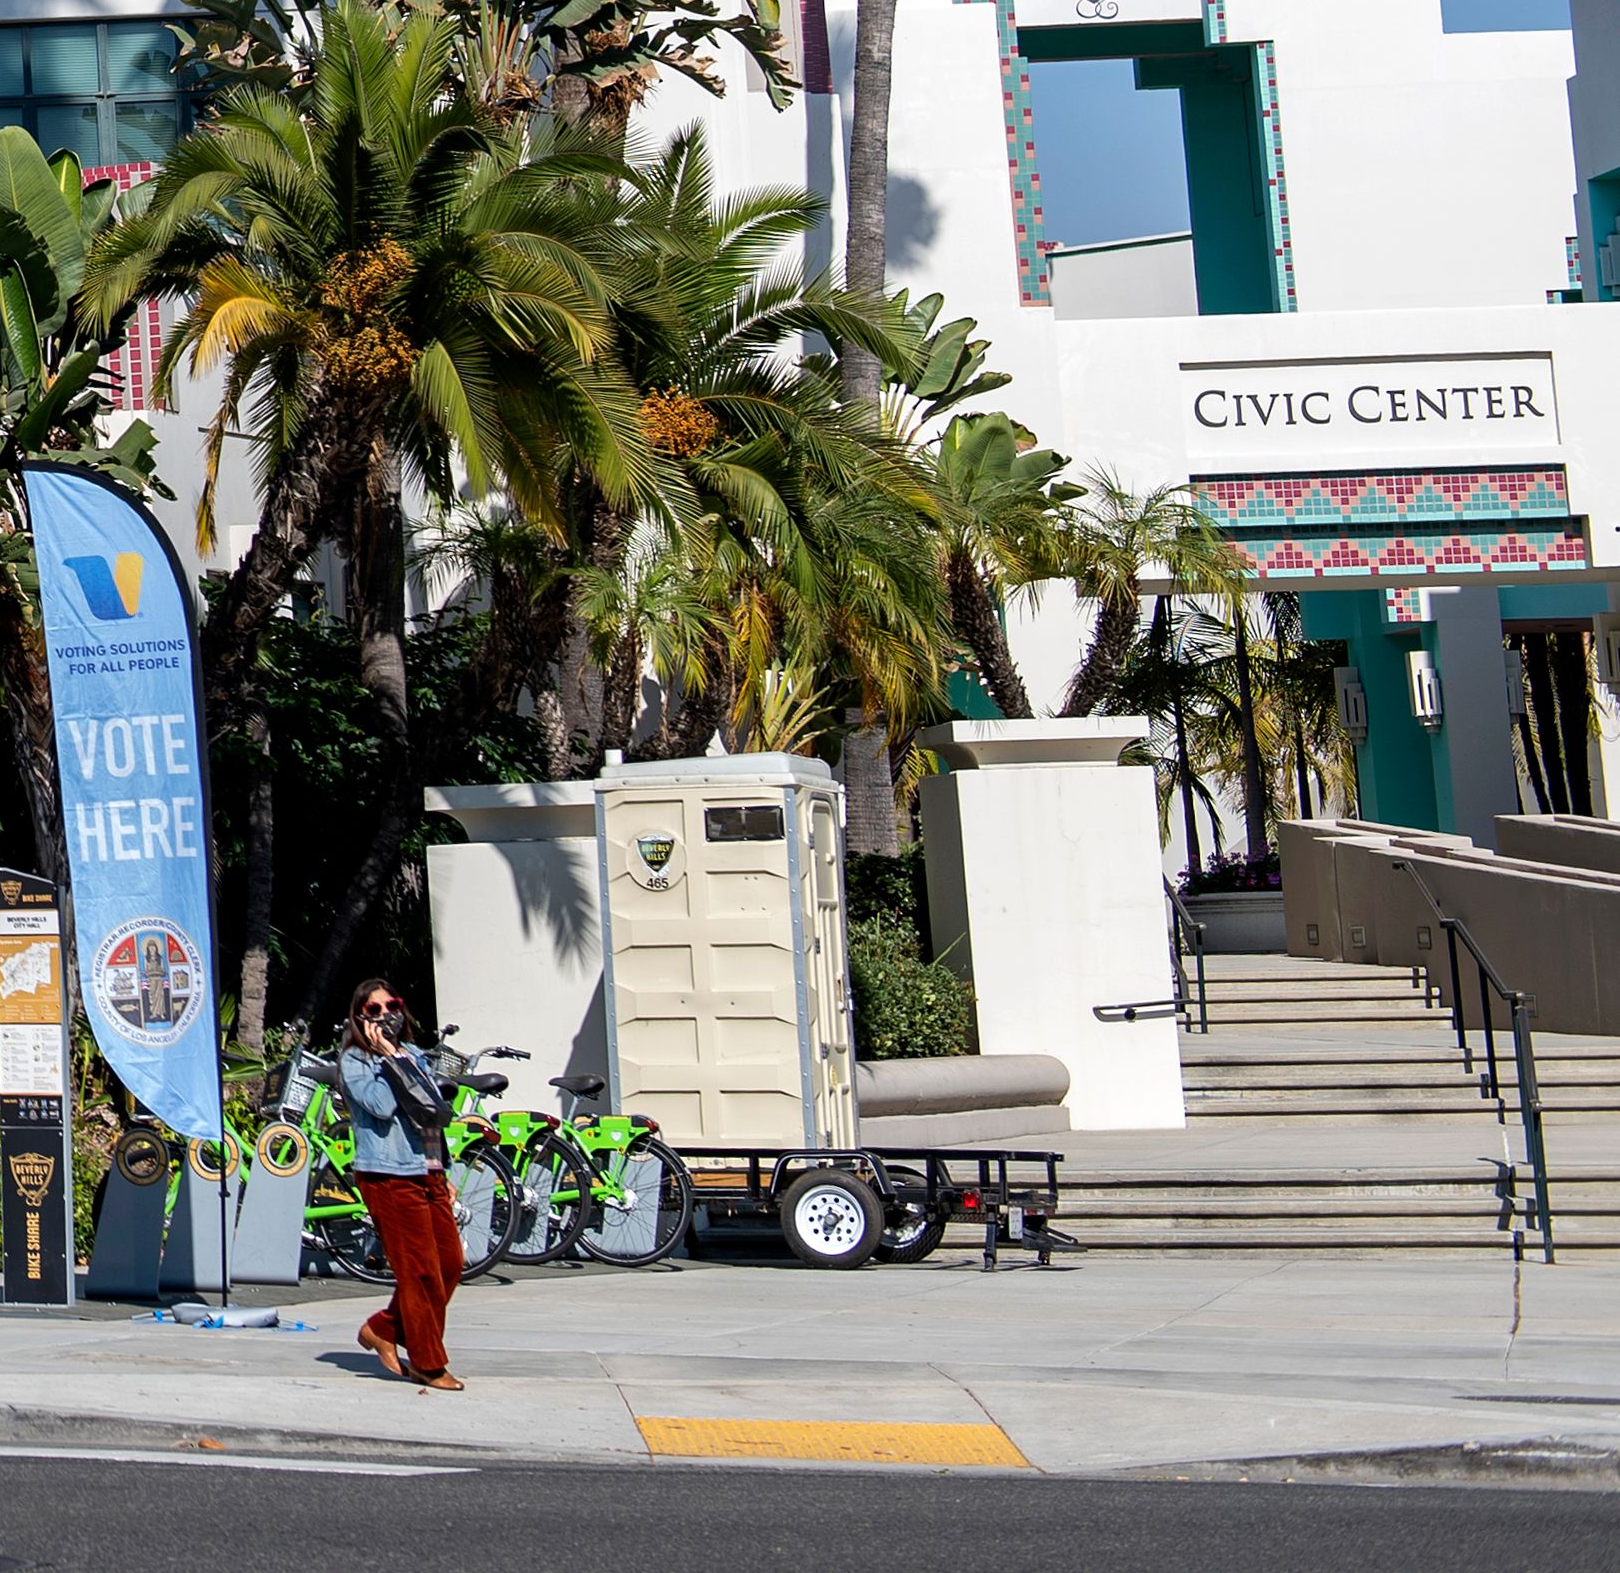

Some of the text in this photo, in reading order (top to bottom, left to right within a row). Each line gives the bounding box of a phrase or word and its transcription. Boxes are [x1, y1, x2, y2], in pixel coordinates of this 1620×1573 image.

[55, 639, 186, 659] VOTING SOLUTIONS
[69, 657, 180, 675] FOR ALL PEOPLE
[68, 714, 190, 780] VOTE
[75, 796, 198, 863] HERE
[646, 878, 669, 889] 465
[16, 1164, 48, 1175] BEVERLY
[21, 1175, 44, 1185] HILLS
[26, 1211, 41, 1280] BIKE SHARE
